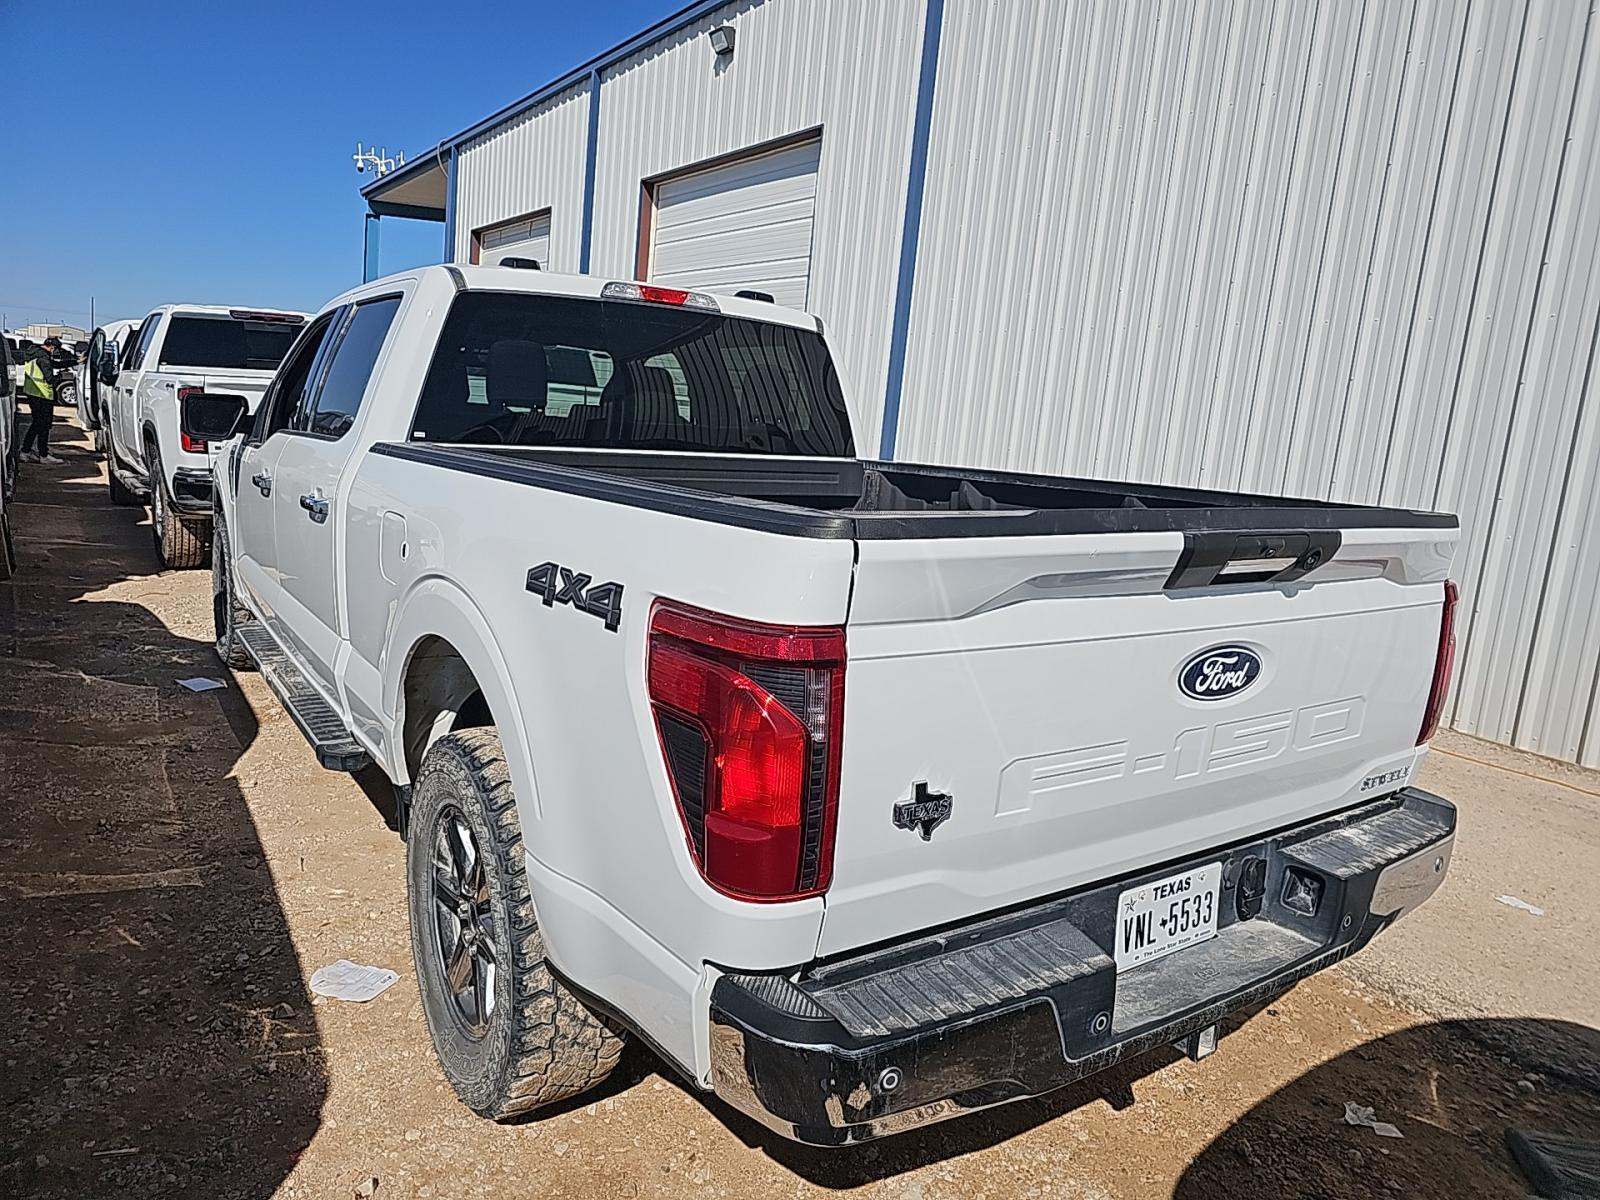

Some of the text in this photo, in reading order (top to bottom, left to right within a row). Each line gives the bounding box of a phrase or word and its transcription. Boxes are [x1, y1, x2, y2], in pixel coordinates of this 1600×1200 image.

[1195, 656, 1251, 694] Ford
[994, 695, 1368, 817] F-150
[904, 798, 950, 821] TEXAS
[1153, 876, 1192, 901] TEXAS
[1124, 890, 1213, 954] VNL 5533
[1143, 950, 1153, 958] The
